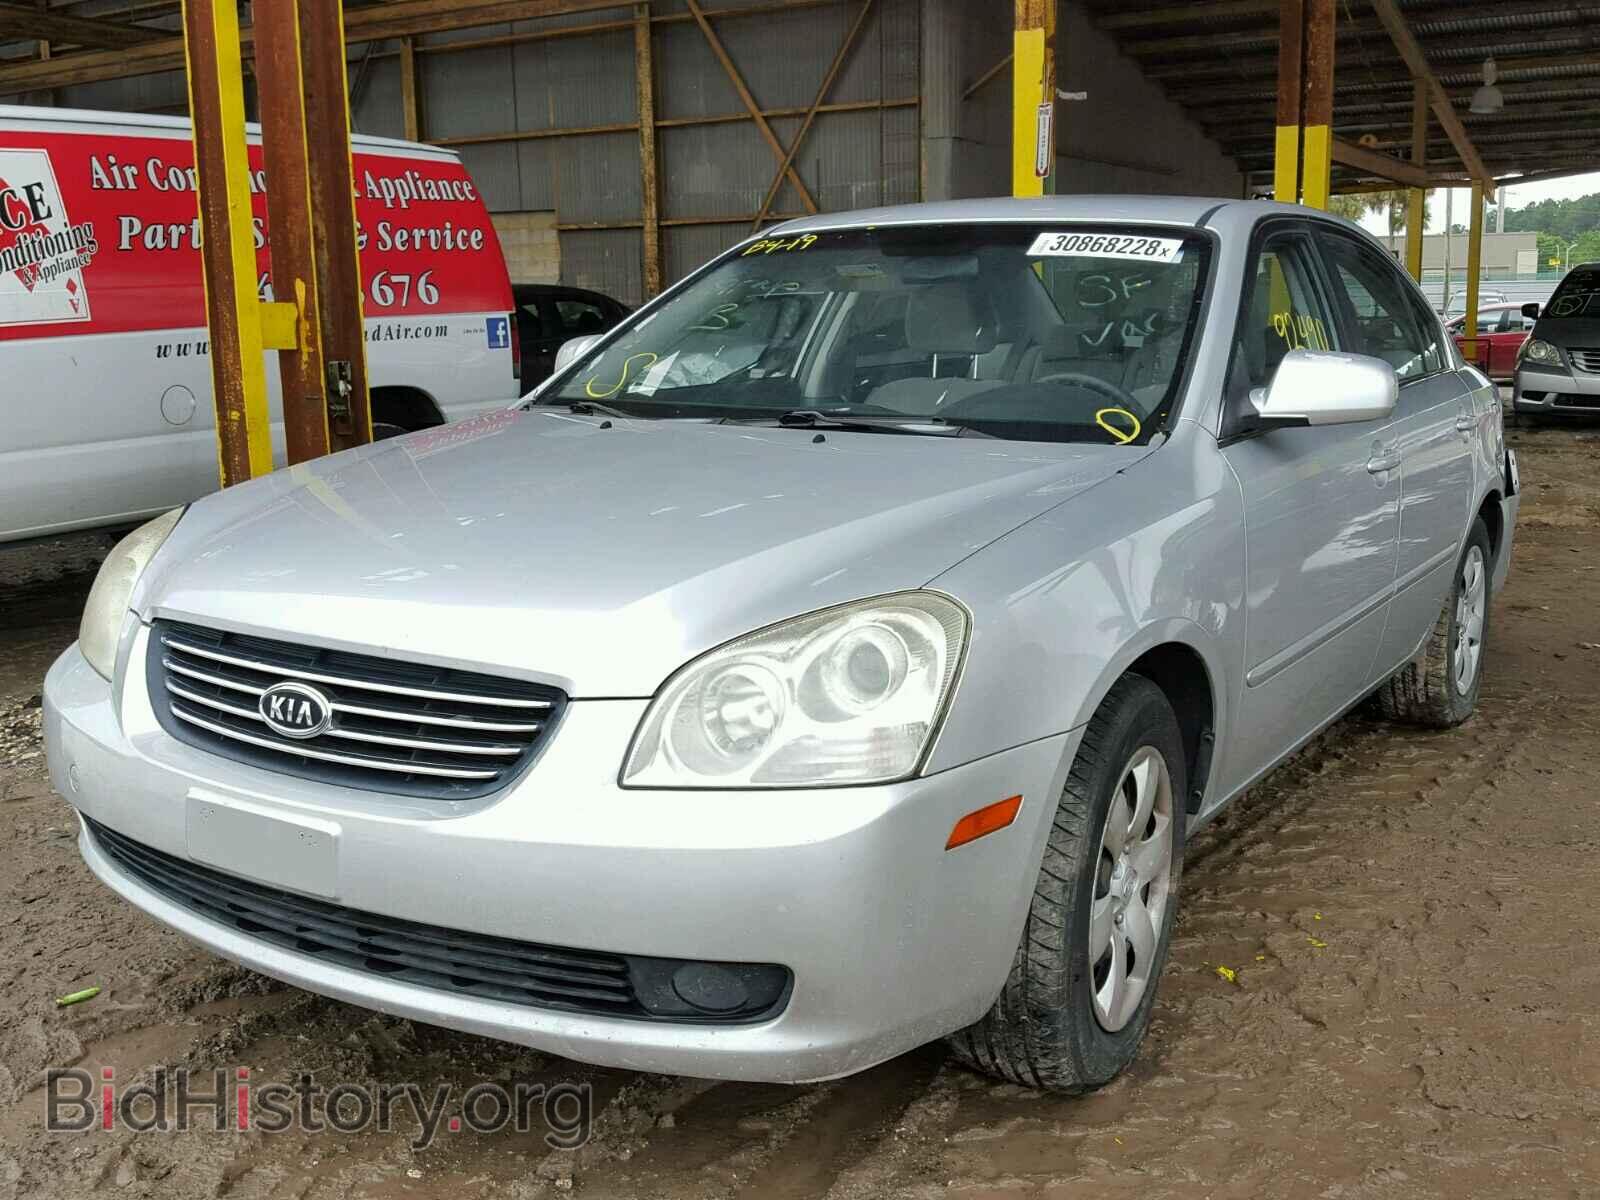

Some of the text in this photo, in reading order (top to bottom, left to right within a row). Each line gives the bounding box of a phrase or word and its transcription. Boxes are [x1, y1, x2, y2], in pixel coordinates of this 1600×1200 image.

[91, 154, 138, 190] Air
[364, 169, 477, 209] Appliance
[0, 182, 53, 231] CE
[0, 222, 97, 275] nditioning
[118, 216, 203, 250] Part
[376, 221, 485, 251] Service
[36, 252, 92, 284] Appliance
[360, 270, 441, 308] 676
[270, 694, 313, 726] KIA
